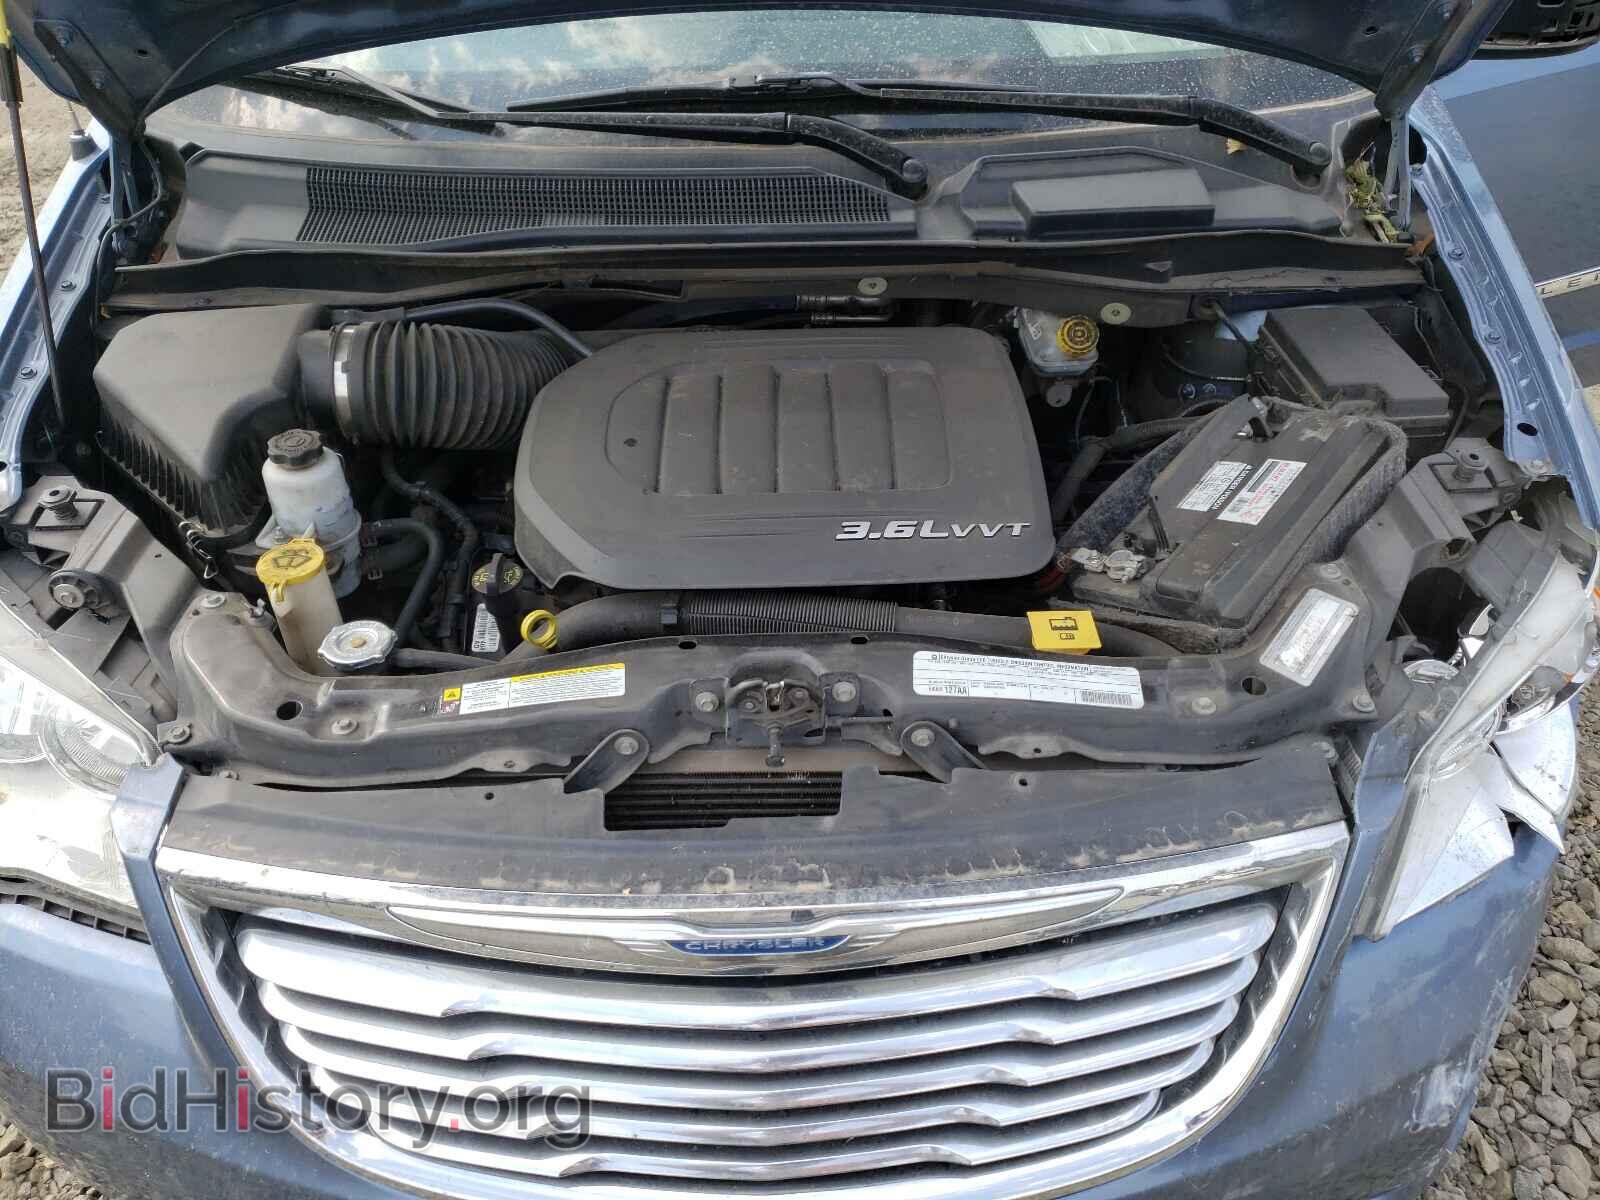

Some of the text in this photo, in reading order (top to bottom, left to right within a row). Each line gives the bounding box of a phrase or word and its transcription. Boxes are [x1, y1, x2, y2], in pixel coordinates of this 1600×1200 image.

[1541, 273, 1600, 295] LE
[835, 519, 1032, 540] 3.6L VVT
[685, 937, 825, 950] CHRYSLER
